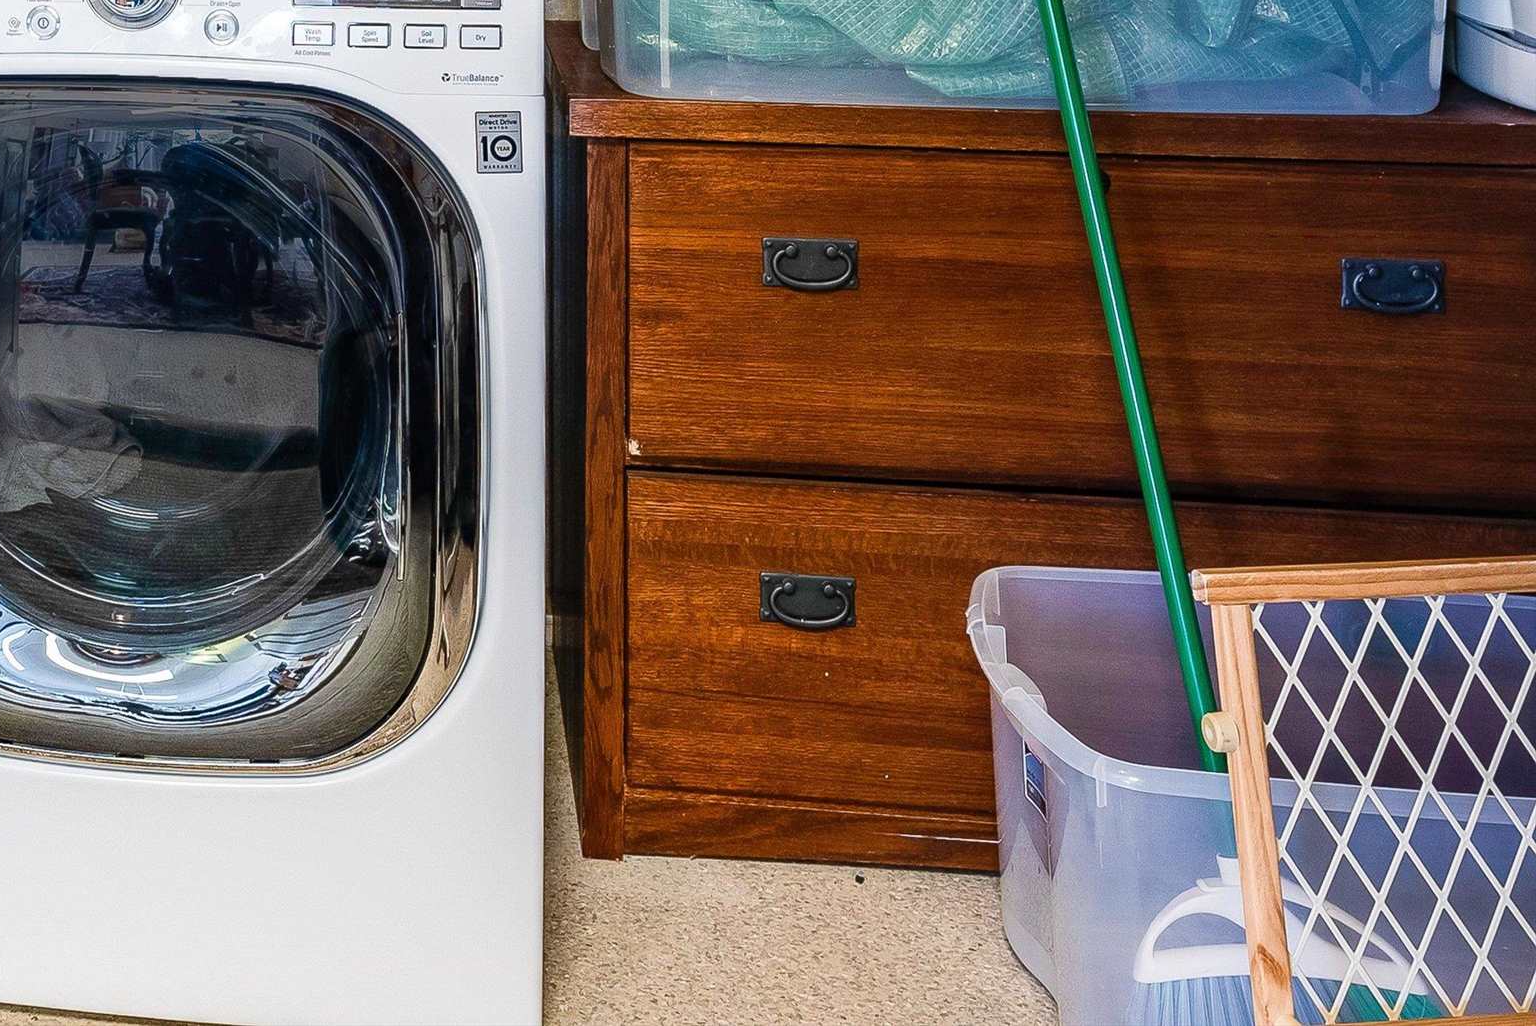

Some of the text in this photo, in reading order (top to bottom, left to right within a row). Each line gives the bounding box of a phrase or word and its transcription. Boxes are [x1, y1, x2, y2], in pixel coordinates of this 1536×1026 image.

[363, 30, 377, 38] Spin
[475, 34, 487, 42] Dry
[361, 36, 379, 44] Speed
[452, 73, 500, 83] TrueBalance
[480, 135, 517, 162] 10
